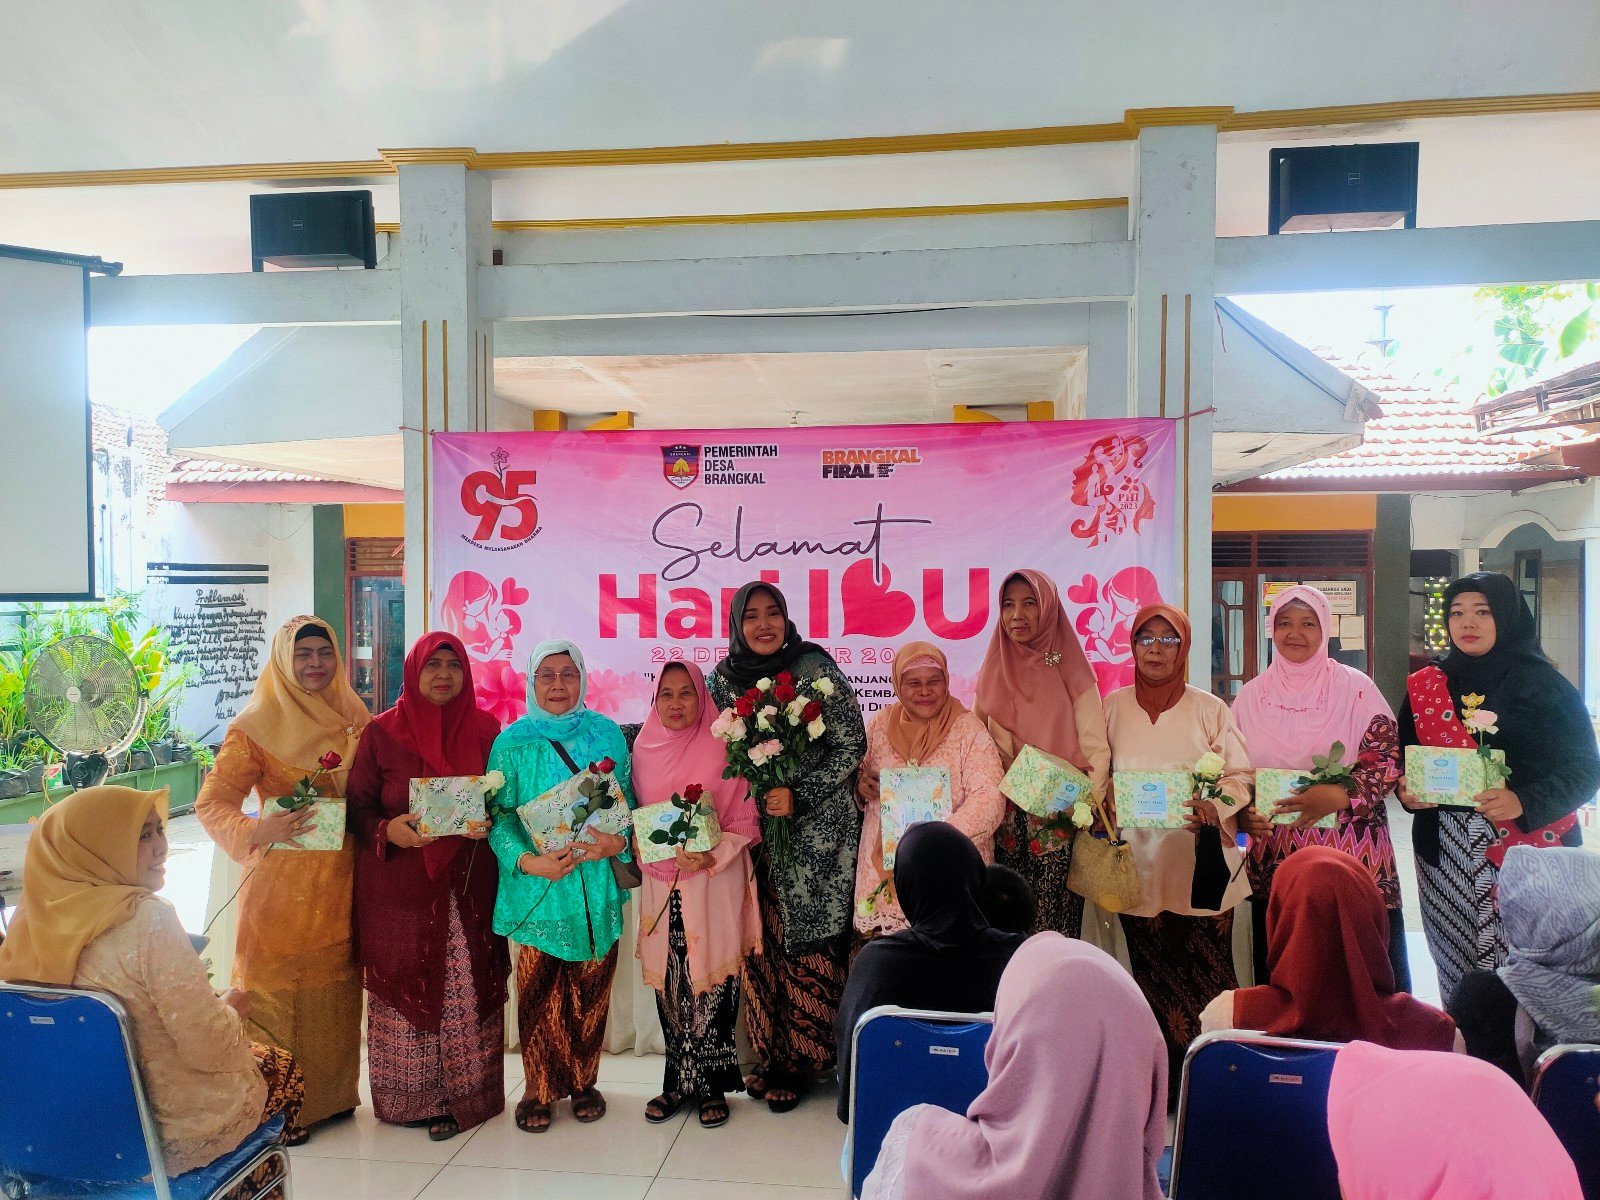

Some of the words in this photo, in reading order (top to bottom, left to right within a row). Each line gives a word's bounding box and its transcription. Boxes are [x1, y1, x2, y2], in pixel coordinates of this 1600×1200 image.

[703, 445, 778, 458] PEMERINTAH
[822, 449, 921, 464] BRANGKAL
[704, 459, 735, 471] DESA
[822, 464, 875, 478] FIRAL
[704, 472, 766, 485] BRANGKAL
[460, 470, 539, 541] 95
[651, 502, 932, 583] Selamat
[651, 646, 685, 663] 22
